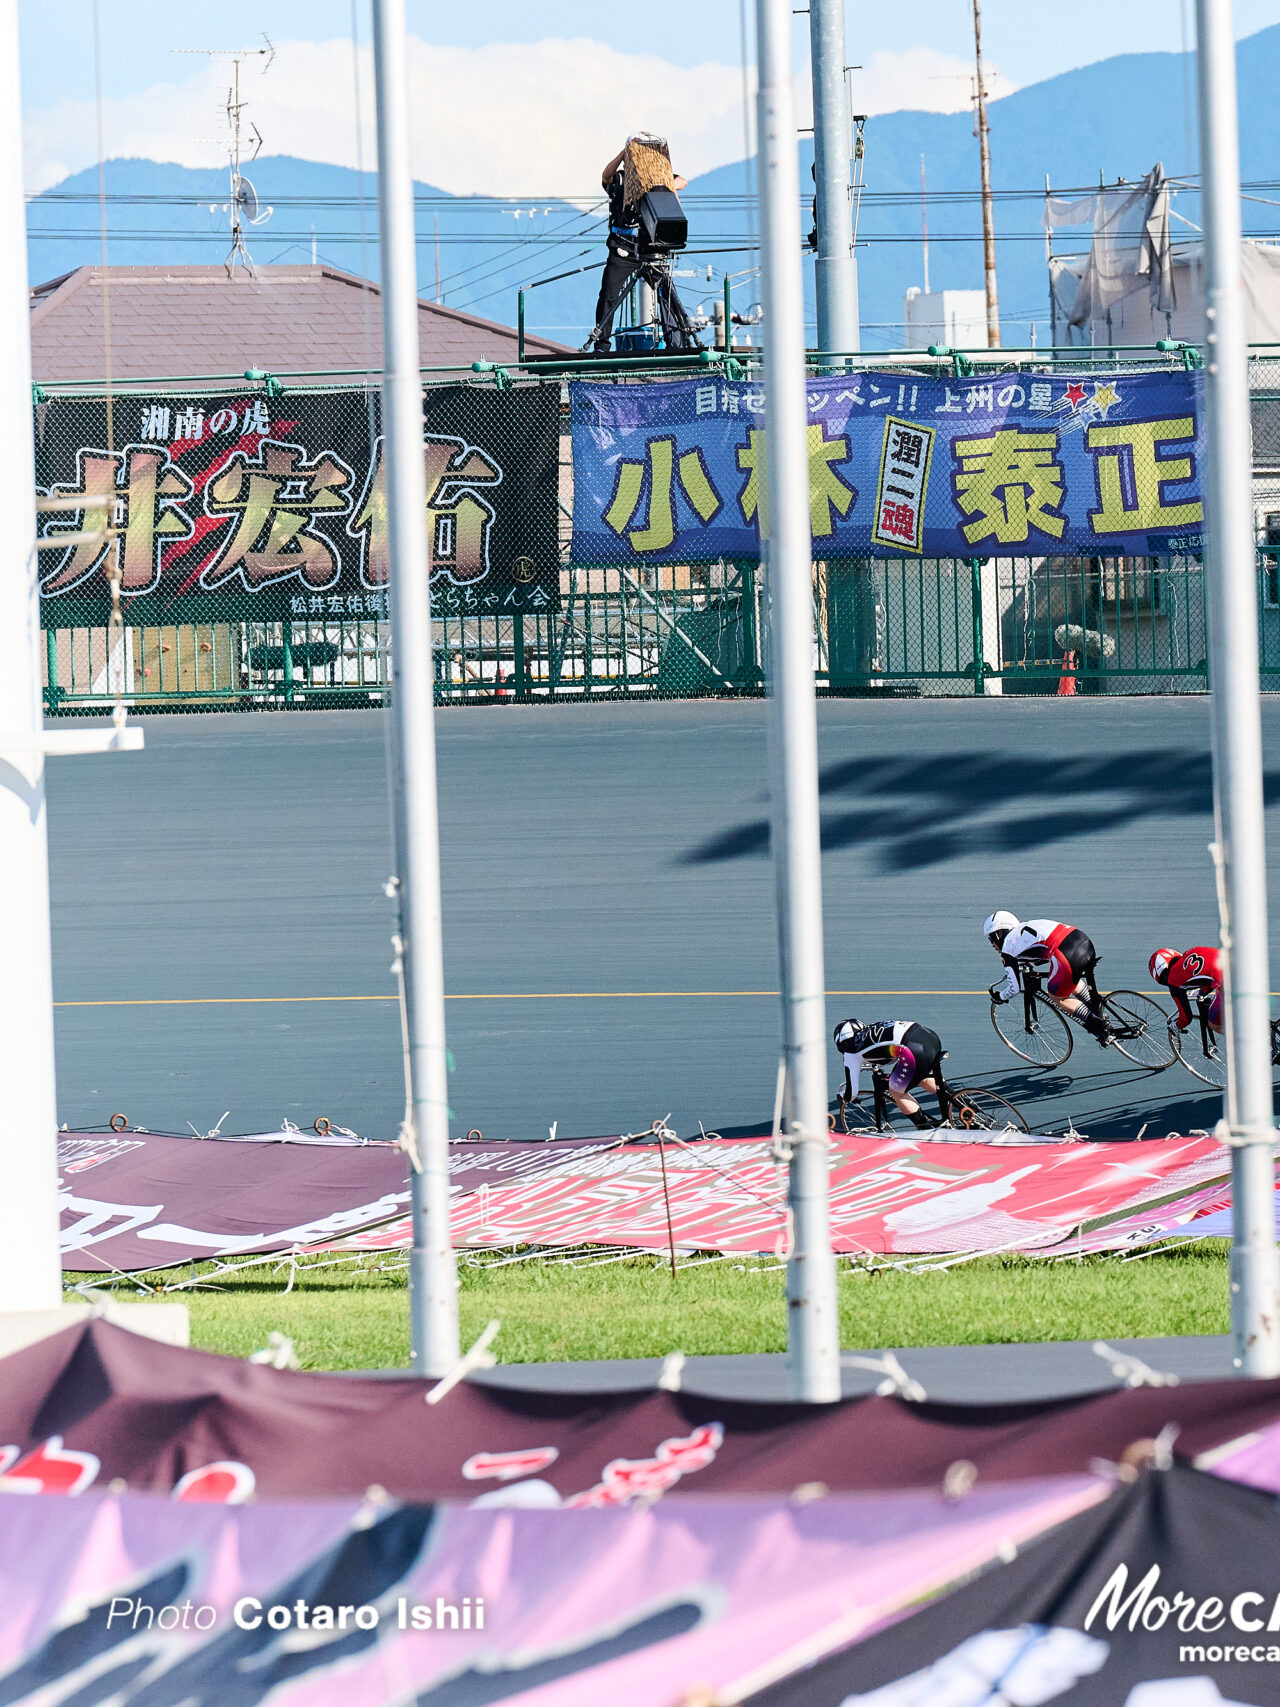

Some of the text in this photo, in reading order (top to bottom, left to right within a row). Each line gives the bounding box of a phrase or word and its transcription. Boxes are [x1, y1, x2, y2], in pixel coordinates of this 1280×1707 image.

[935, 383, 1051, 413] 上州の星
[140, 400, 270, 440] 湘南の虎
[1183, 952, 1205, 977] 3
